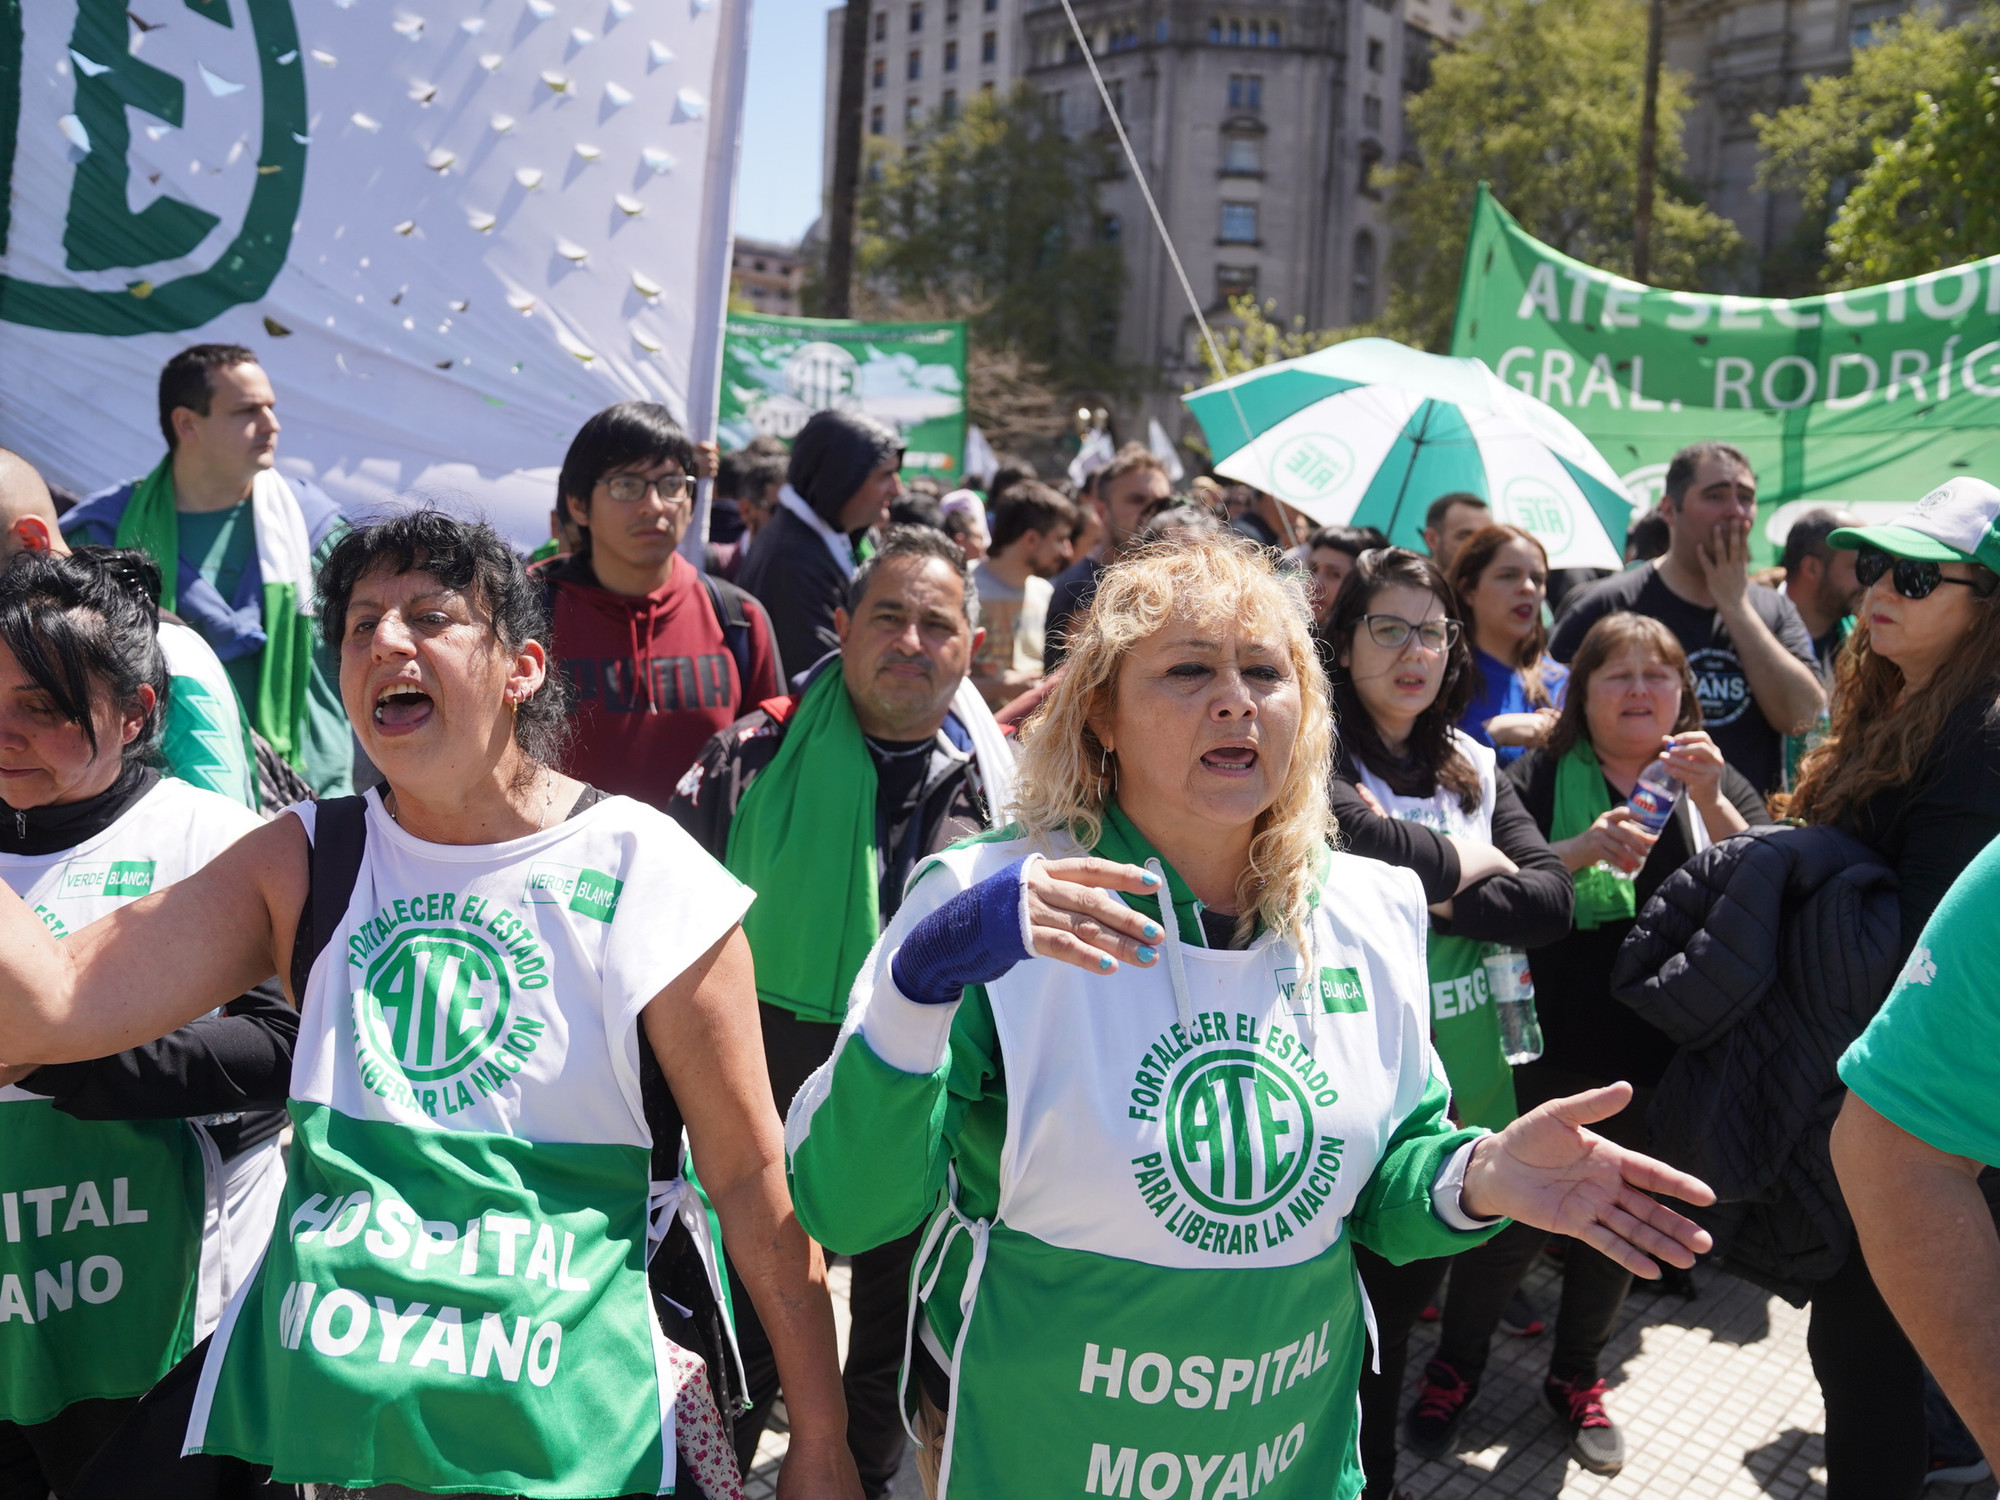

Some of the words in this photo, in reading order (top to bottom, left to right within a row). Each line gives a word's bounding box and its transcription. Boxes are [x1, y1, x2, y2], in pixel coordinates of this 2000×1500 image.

[1517, 261, 1642, 328] ATE
[1497, 346, 1682, 412] GRAL.
[67, 873, 104, 887] VERDE
[107, 871, 150, 886] BLANCA
[532, 874, 573, 895] VERDE
[460, 895, 488, 927] EL
[486, 909, 549, 990] ESTADO
[372, 940, 492, 1066] ATE
[443, 1080, 475, 1115] LA
[470, 1015, 545, 1098] NACION
[1129, 1012, 1230, 1121] FORTALECER
[1237, 1014, 1260, 1044] EL
[1266, 1026, 1338, 1107] ESTADO
[1180, 1064, 1296, 1199] ATE
[2, 1177, 148, 1242] ITAL
[289, 1190, 590, 1291] HOSPITAL
[1131, 1152, 1177, 1218] PARA
[1165, 1203, 1258, 1254] LIBERAR
[1264, 1216, 1293, 1248] LA
[1288, 1136, 1345, 1227] NACION
[0, 1255, 123, 1324] ANO
[280, 1281, 562, 1387] MOYANO
[1080, 1320, 1329, 1410] HOSPITAL
[1085, 1422, 1305, 1500] MOYANO
